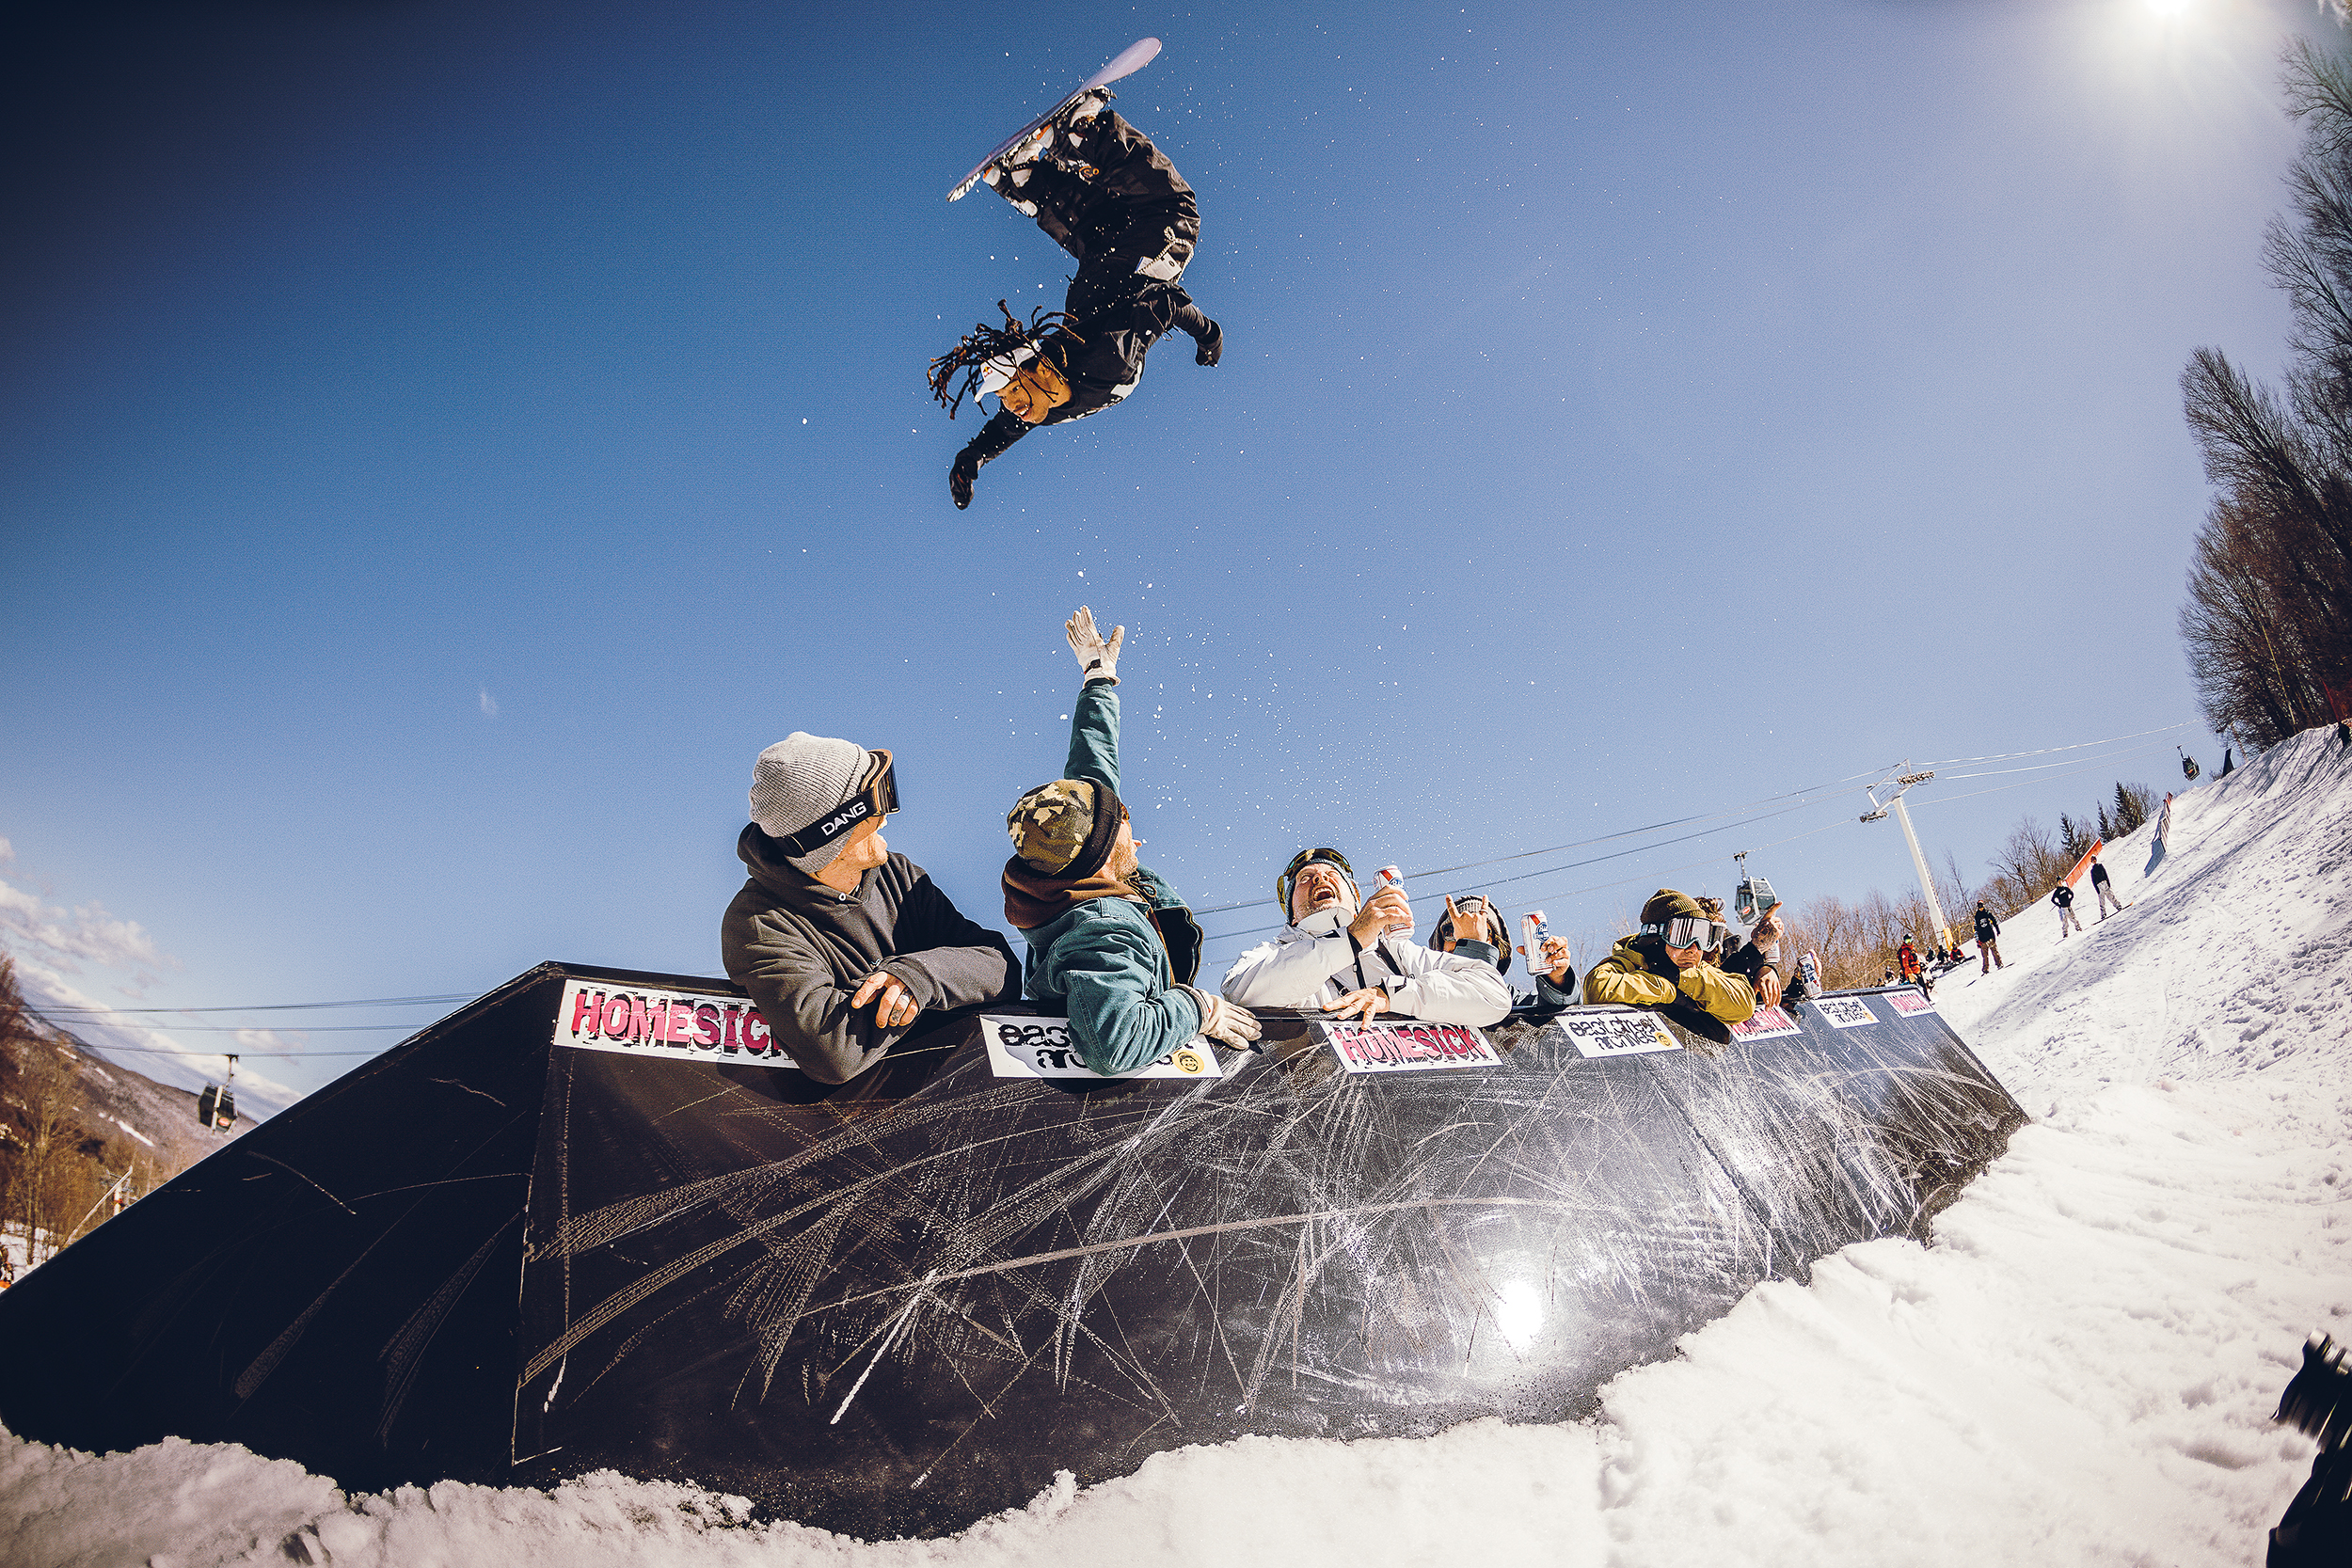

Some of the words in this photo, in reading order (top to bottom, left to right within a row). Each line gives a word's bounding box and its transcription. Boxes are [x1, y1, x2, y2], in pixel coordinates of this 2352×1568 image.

[820, 800, 867, 836] DANG
[570, 988, 782, 1056] HOMESIC
[997, 1023, 1070, 1047] eas
[1568, 1017, 1612, 1037] east
[1609, 1015, 1661, 1035] street
[1333, 1023, 1488, 1065] HOMESICK
[1594, 1031, 1658, 1051] archives
